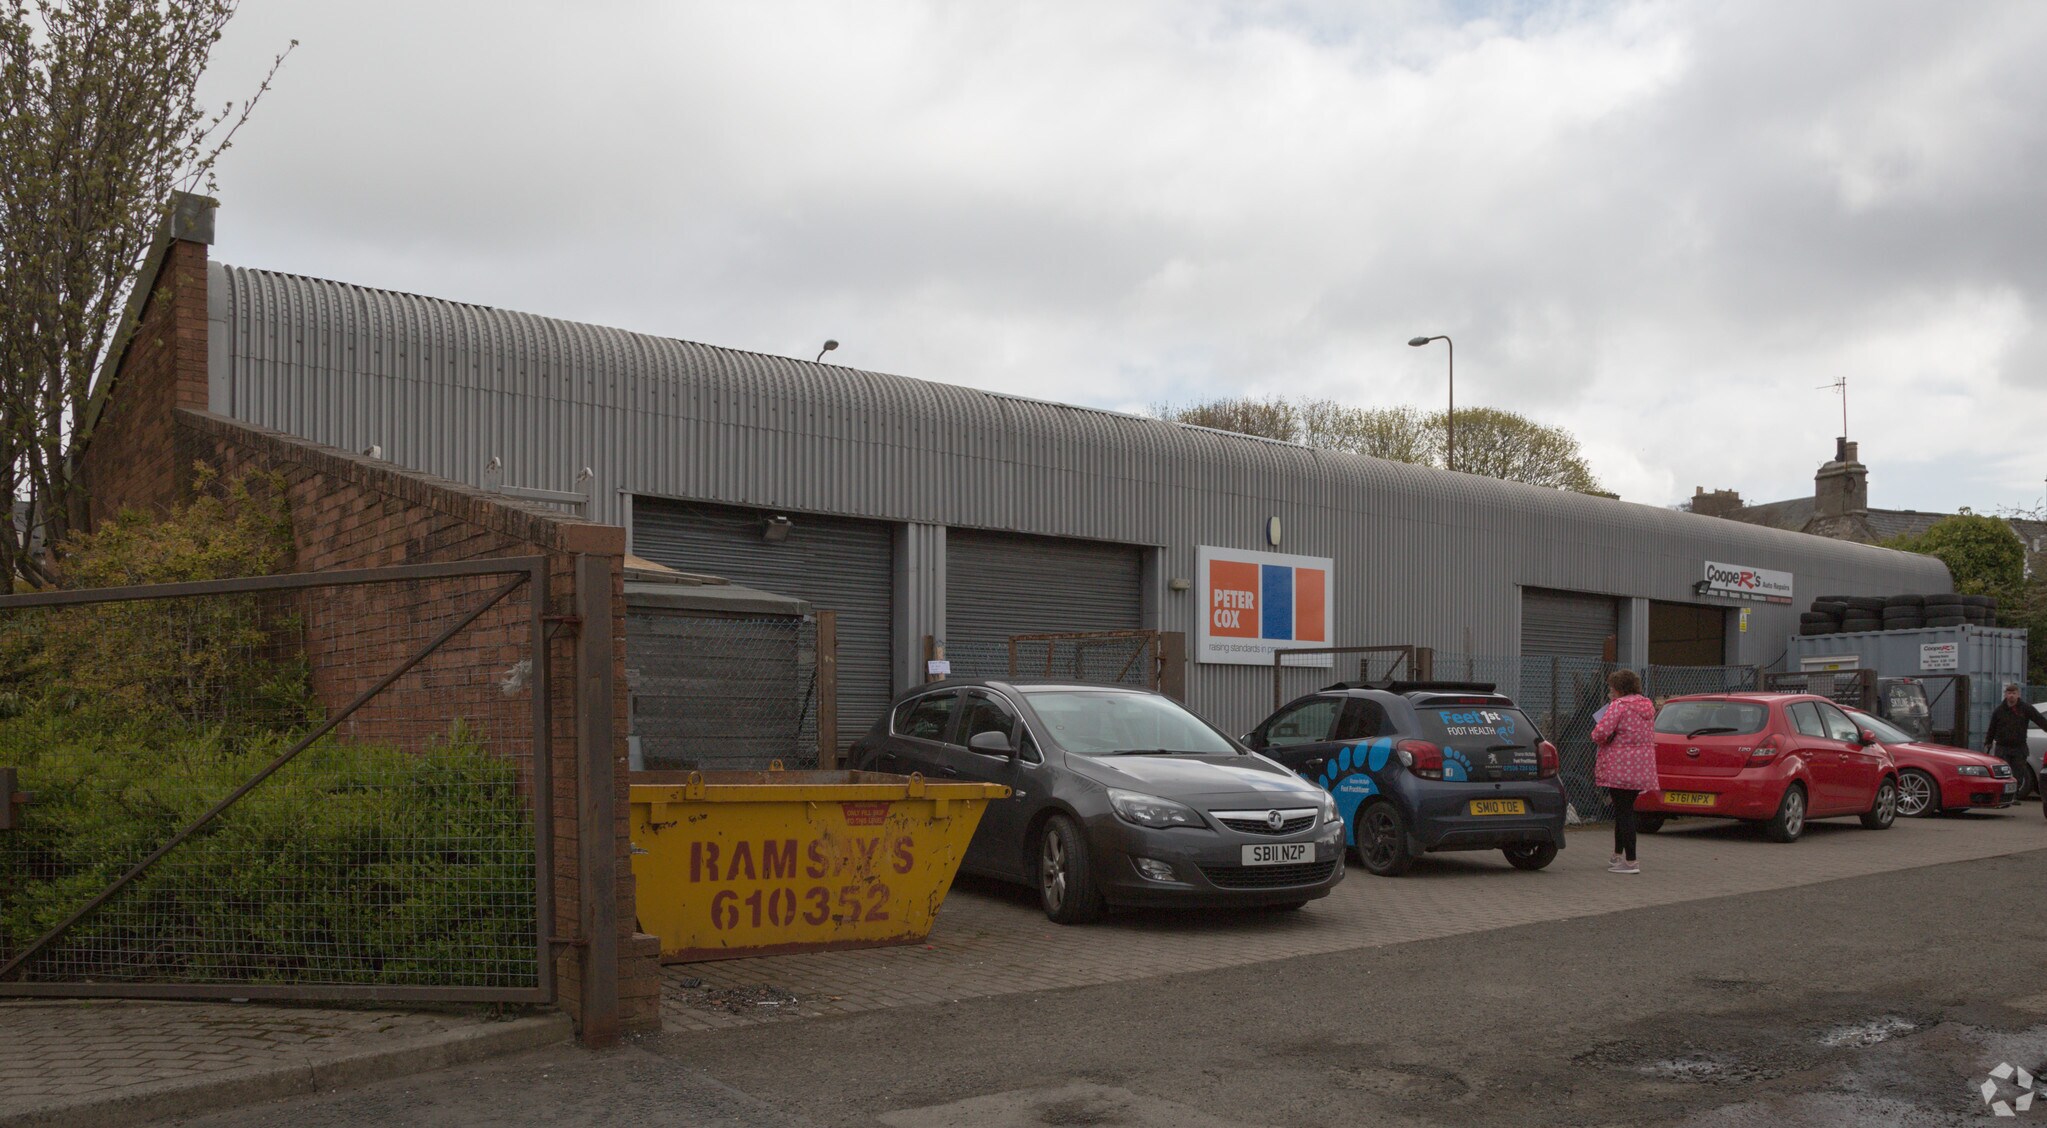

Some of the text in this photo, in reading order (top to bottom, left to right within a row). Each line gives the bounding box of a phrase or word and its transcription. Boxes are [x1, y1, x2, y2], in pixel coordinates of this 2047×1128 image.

[1707, 564, 1790, 592] CoopeR's Auto Repairs
[1214, 588, 1255, 610] PETER
[1213, 608, 1241, 629] COX
[1208, 642, 1229, 654] raising
[1230, 644, 1260, 654] standards
[1447, 727, 1497, 736] FOOT HEALTH
[1501, 801, 1519, 813] TOE
[1282, 844, 1305, 861] NZP
[711, 883, 890, 930] 610352
